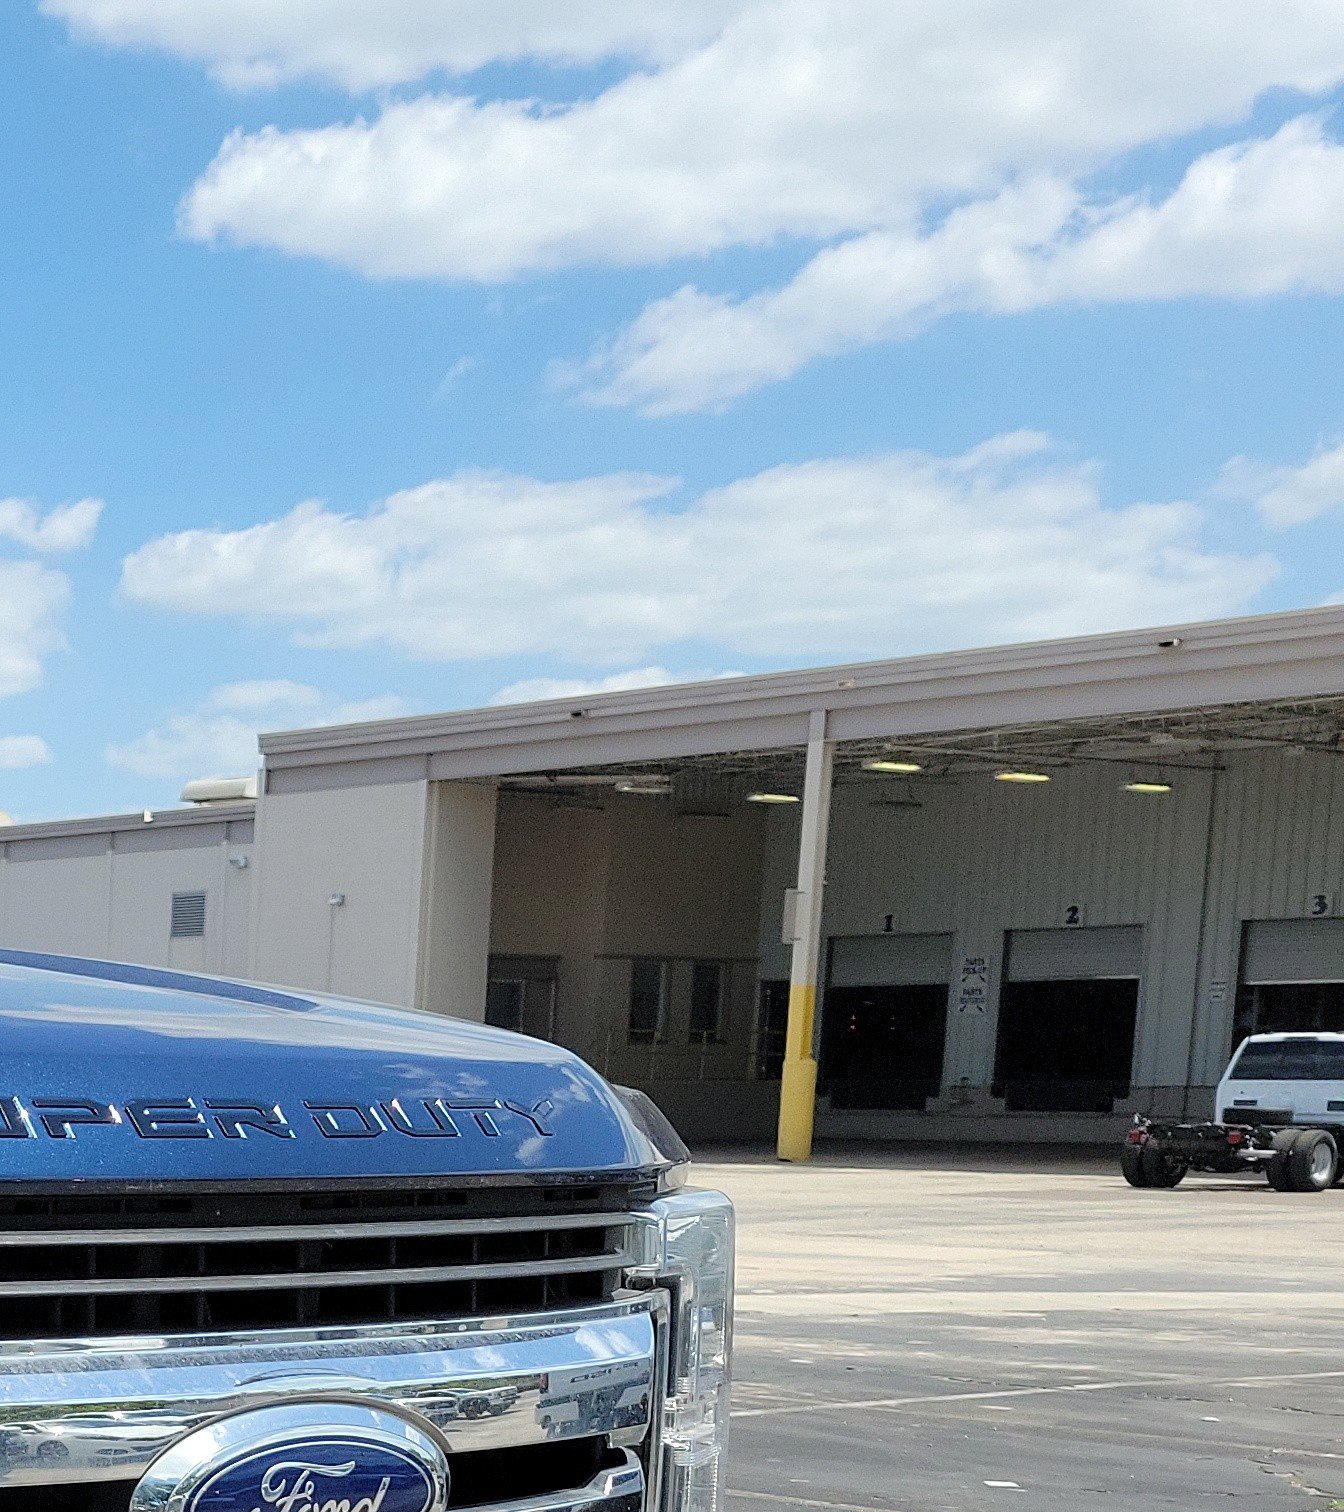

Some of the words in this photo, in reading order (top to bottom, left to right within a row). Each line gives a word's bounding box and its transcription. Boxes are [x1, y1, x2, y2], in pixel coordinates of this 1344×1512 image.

[1065, 905, 1080, 925] 2
[1311, 894, 1329, 916] 3
[883, 914, 894, 932] 1
[300, 1097, 555, 1139] DUTY
